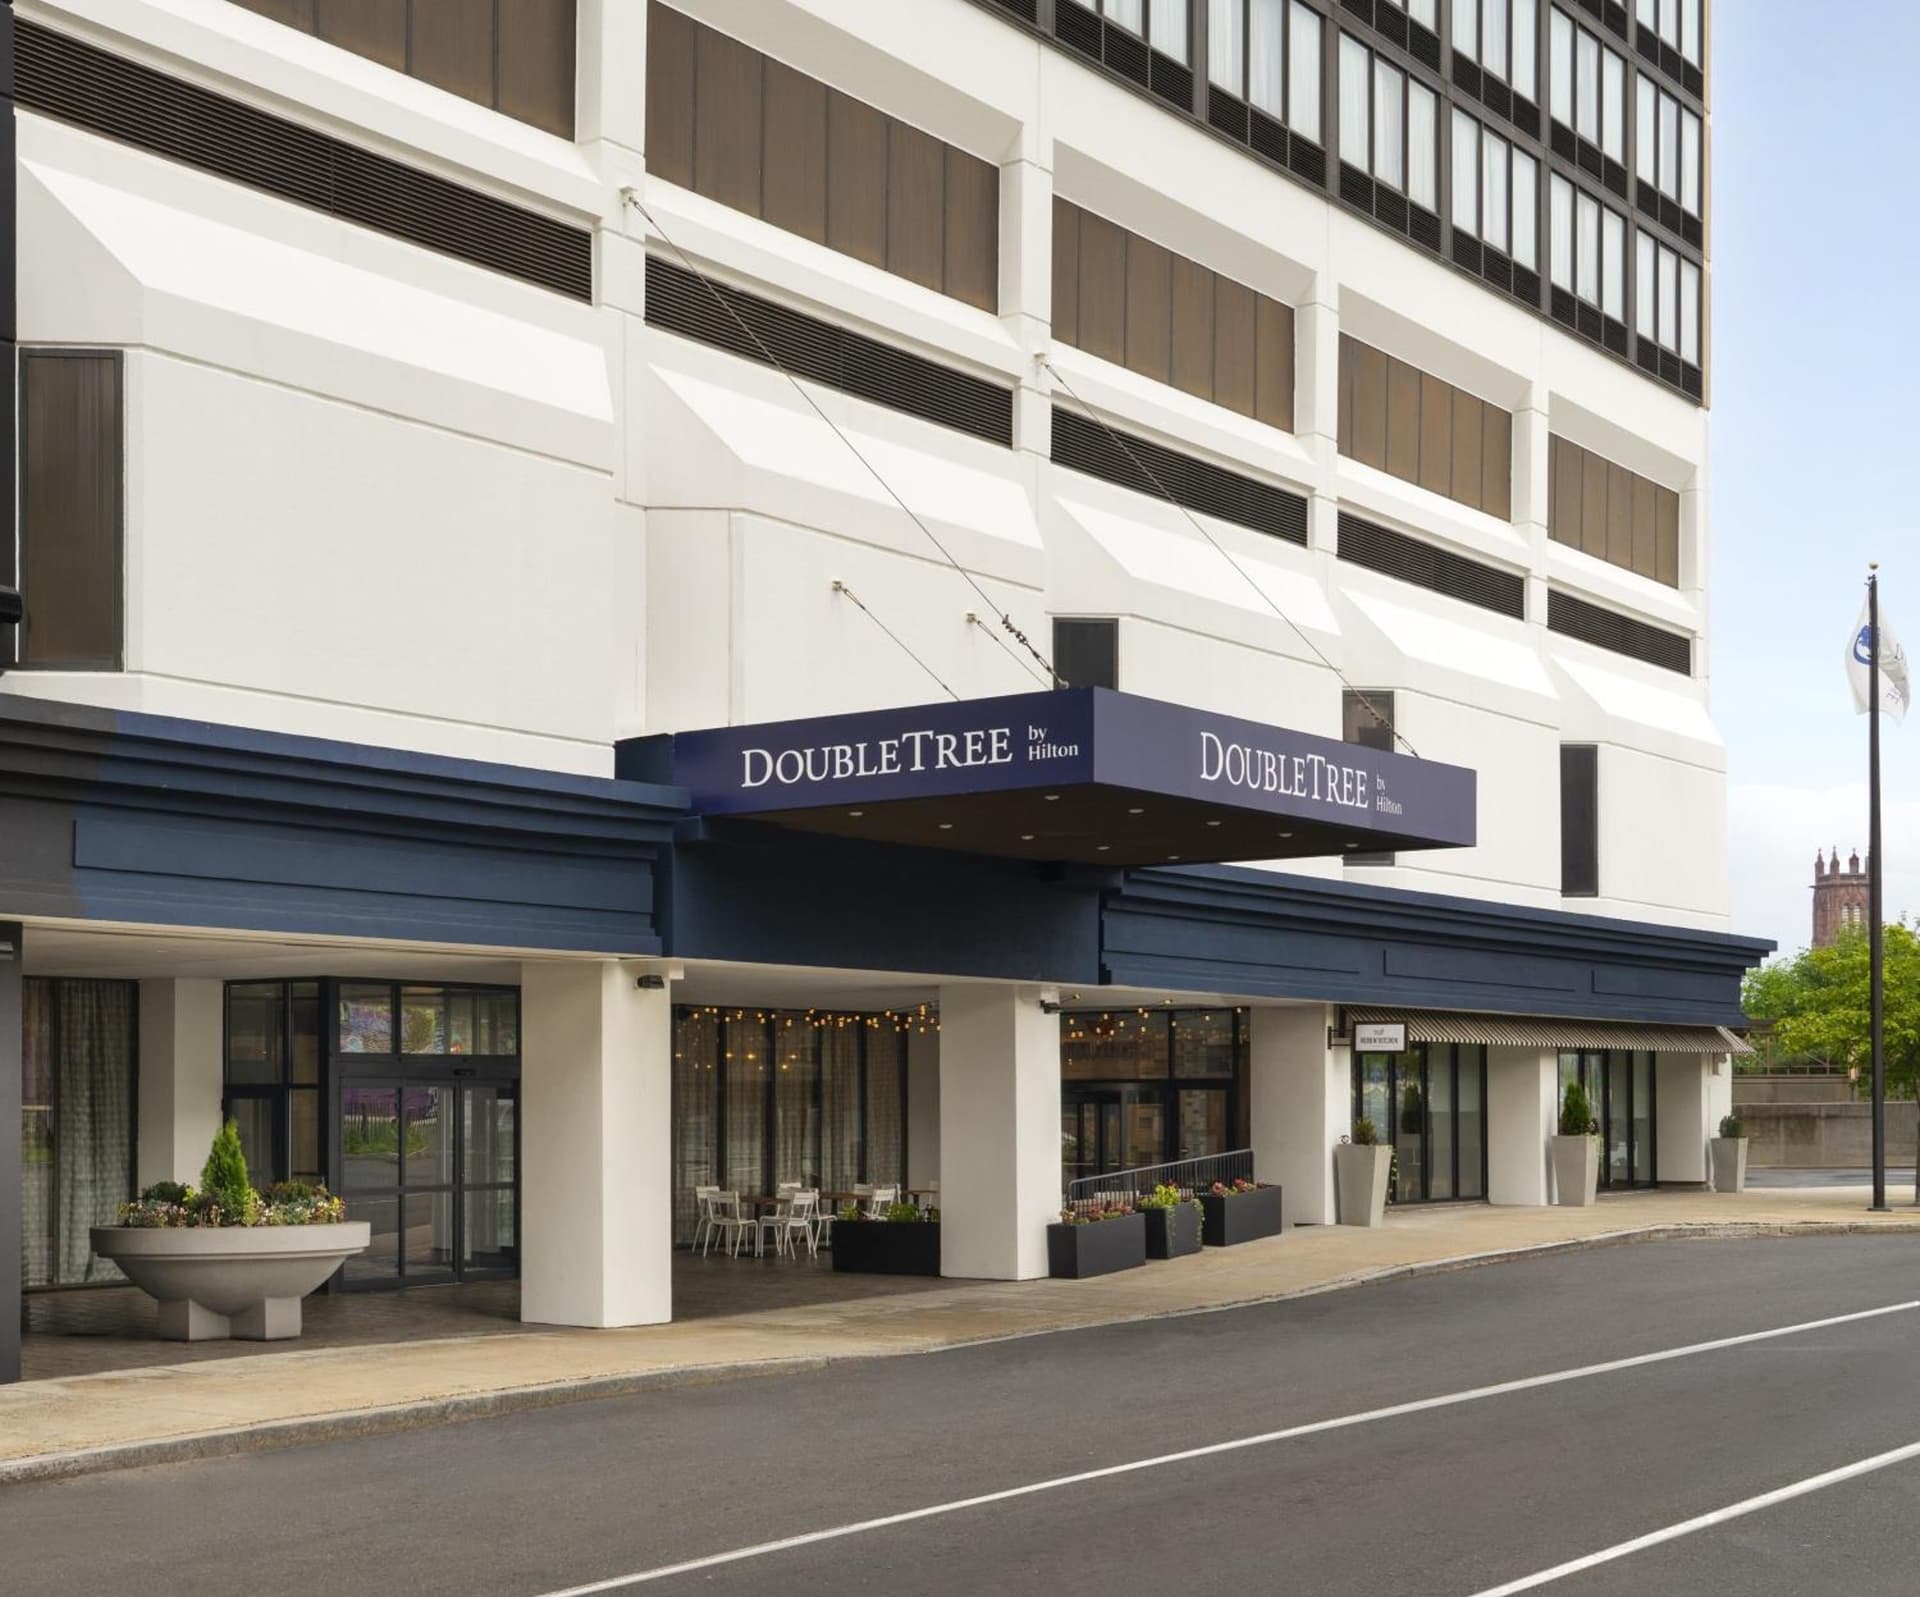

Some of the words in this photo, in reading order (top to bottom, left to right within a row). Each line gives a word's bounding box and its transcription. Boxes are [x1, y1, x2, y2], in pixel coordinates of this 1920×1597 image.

[1028, 725, 1048, 743] by
[1028, 743, 1078, 761] Hilton
[1376, 774, 1386, 795] by
[1376, 795, 1403, 815] Hilton
